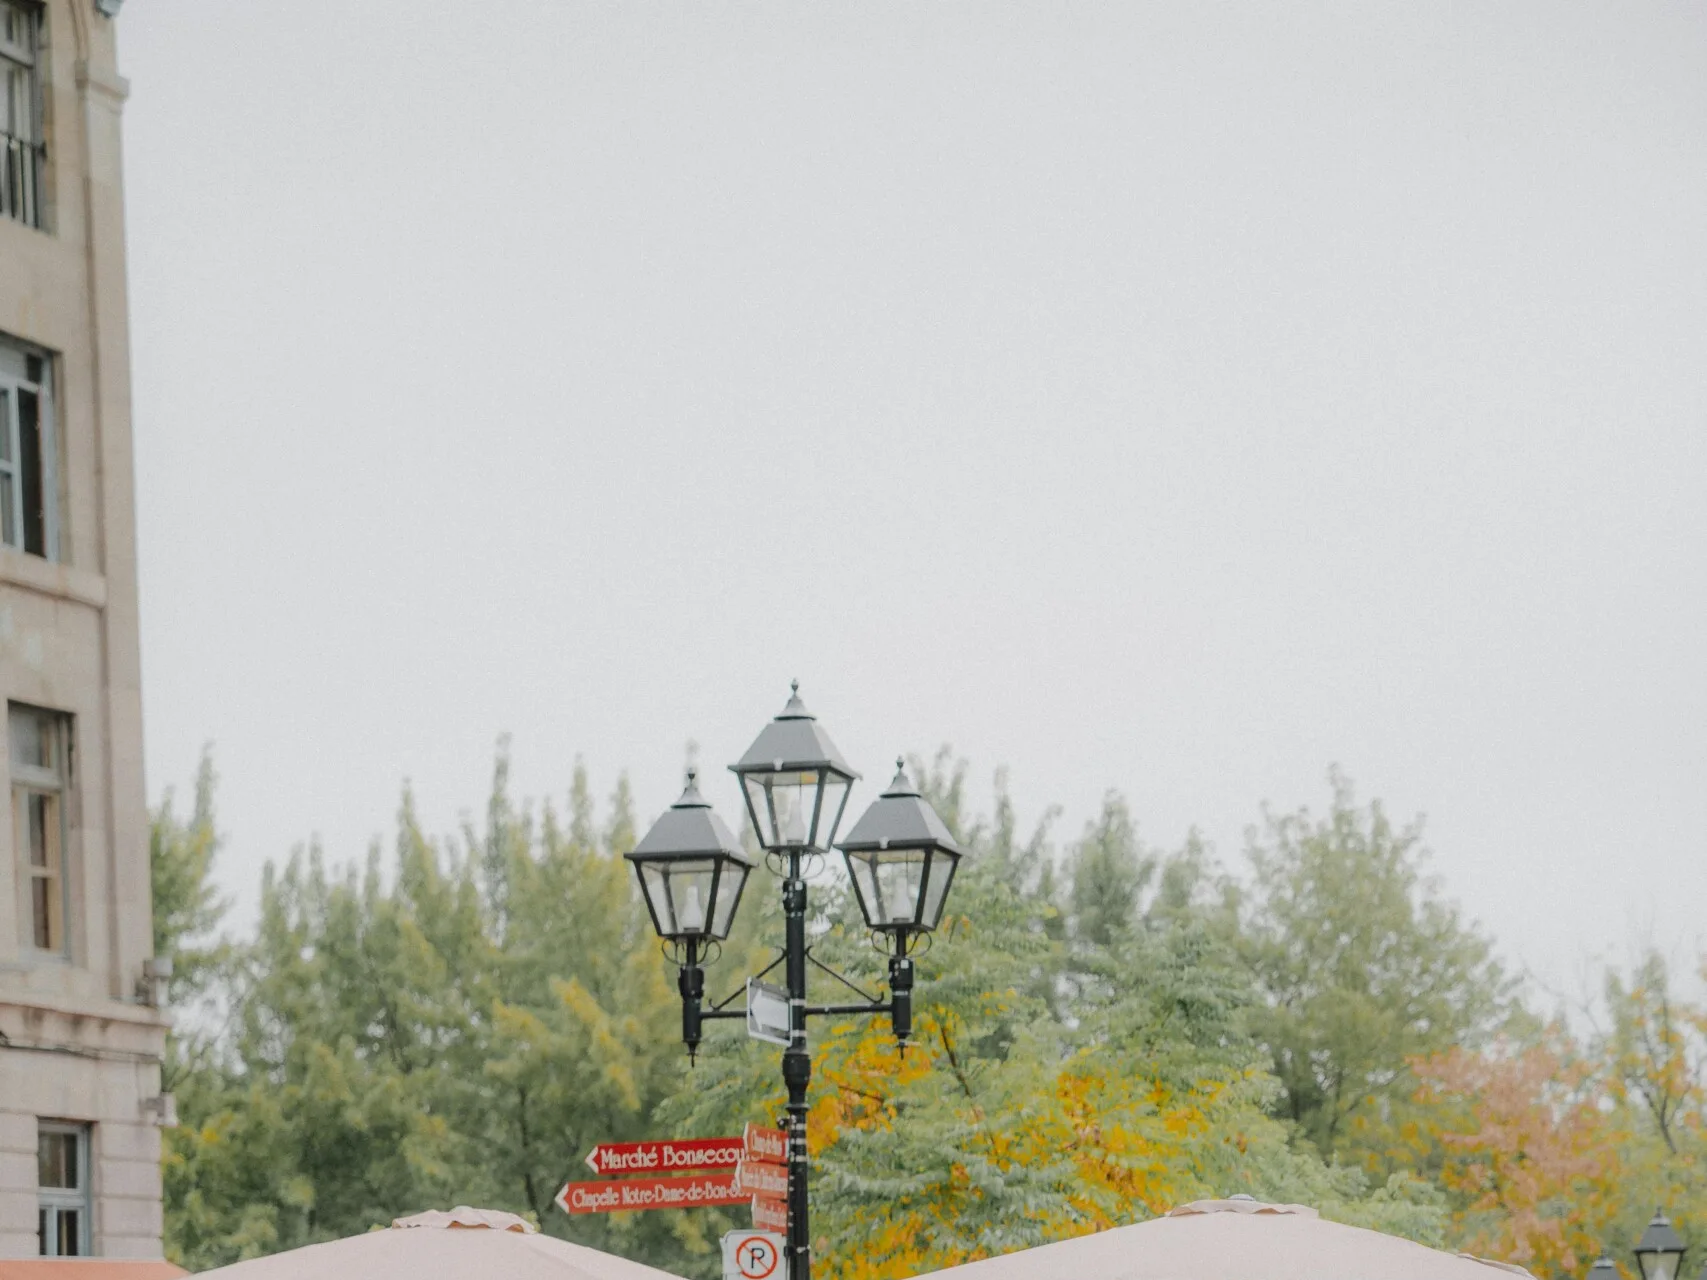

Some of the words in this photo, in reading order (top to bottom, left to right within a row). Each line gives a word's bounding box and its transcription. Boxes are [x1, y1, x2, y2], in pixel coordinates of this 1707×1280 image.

[600, 1145, 658, 1170] Marché
[663, 1145, 759, 1167] Bonsecou
[571, 1186, 619, 1212] Chapelle
